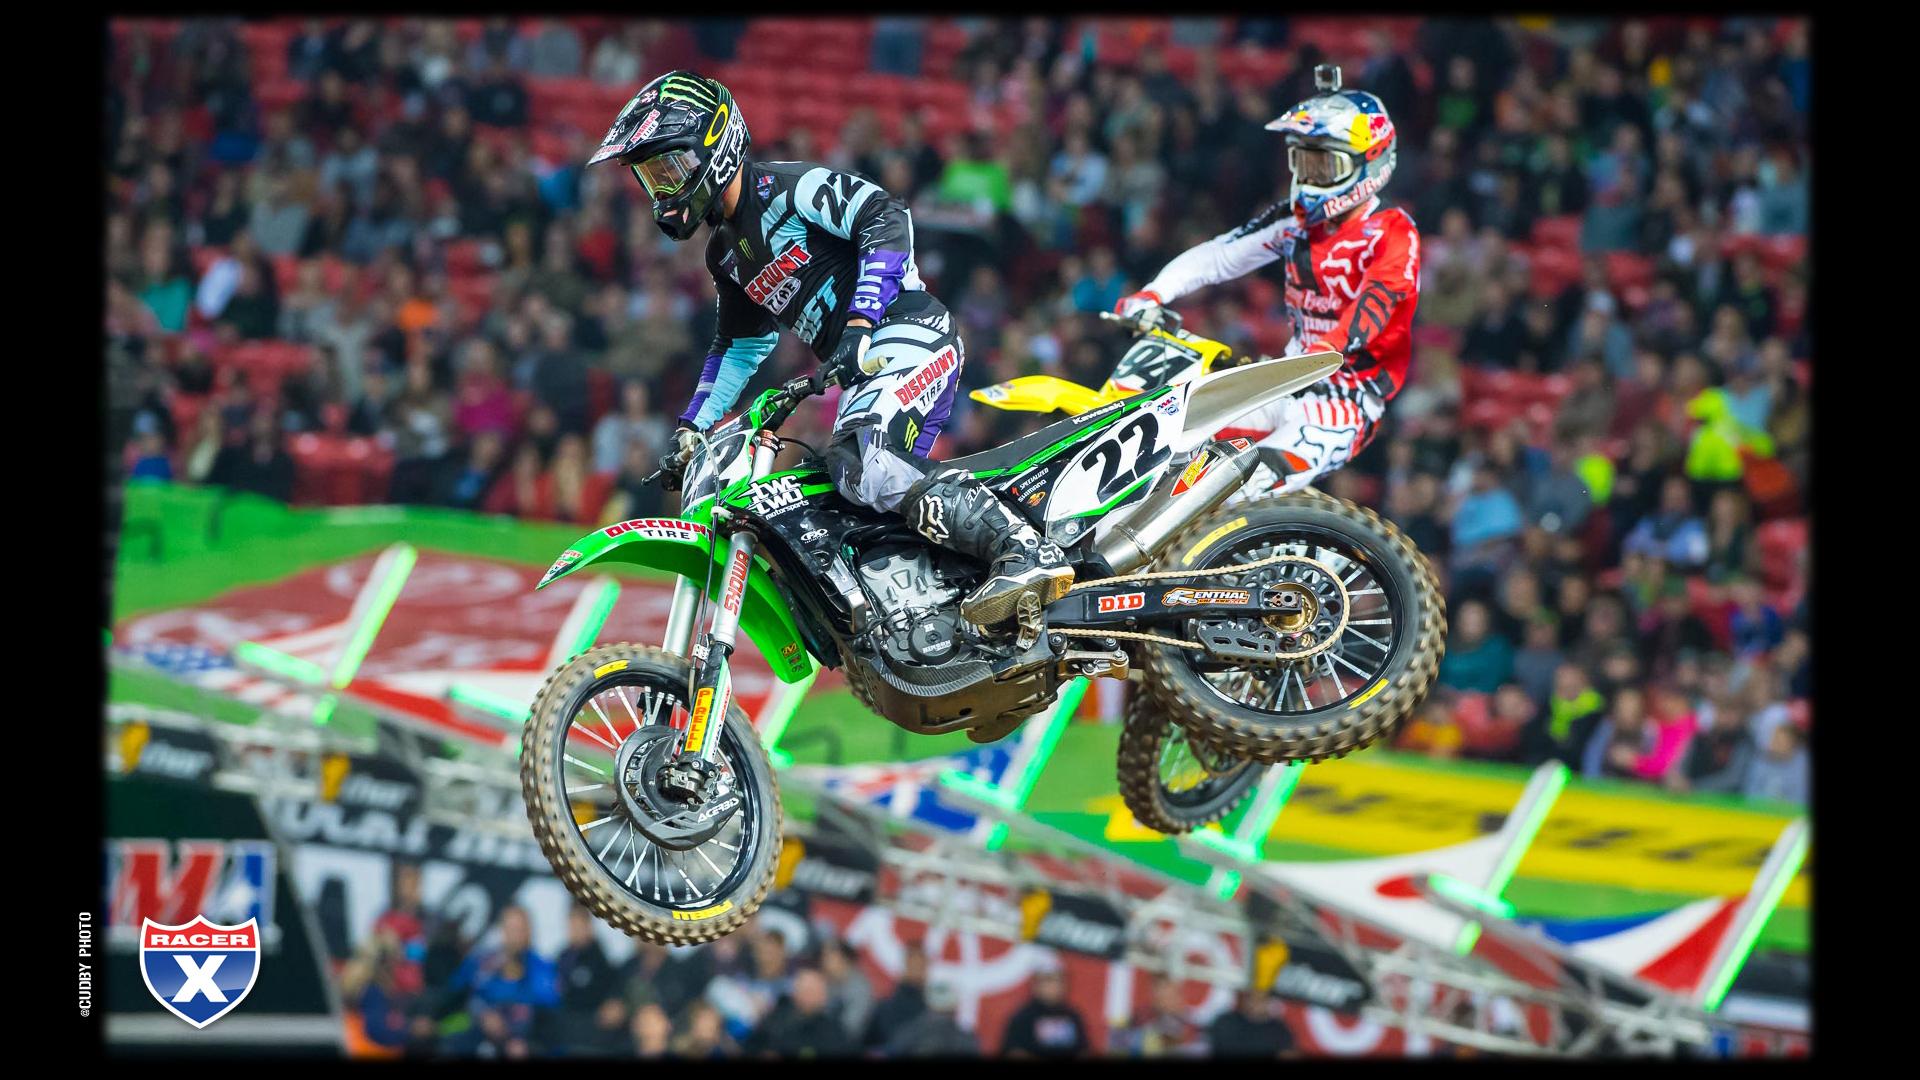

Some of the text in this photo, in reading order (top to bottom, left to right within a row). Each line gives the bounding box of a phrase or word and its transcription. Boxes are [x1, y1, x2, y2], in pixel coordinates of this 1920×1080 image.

[641, 121, 658, 140] TIRE
[812, 173, 864, 229] 22
[894, 348, 955, 406] DISCOUNT
[919, 379, 943, 407] TIRE
[1073, 401, 1125, 425] Kawasaki
[1081, 412, 1172, 503] 22
[1019, 467, 1049, 490] SPECIALIZED
[765, 499, 809, 520] motorsports
[604, 519, 713, 542] DISCOUNT
[643, 529, 691, 540] TIRE
[723, 550, 750, 616] SHOWA
[686, 689, 711, 750] PIRELLI
